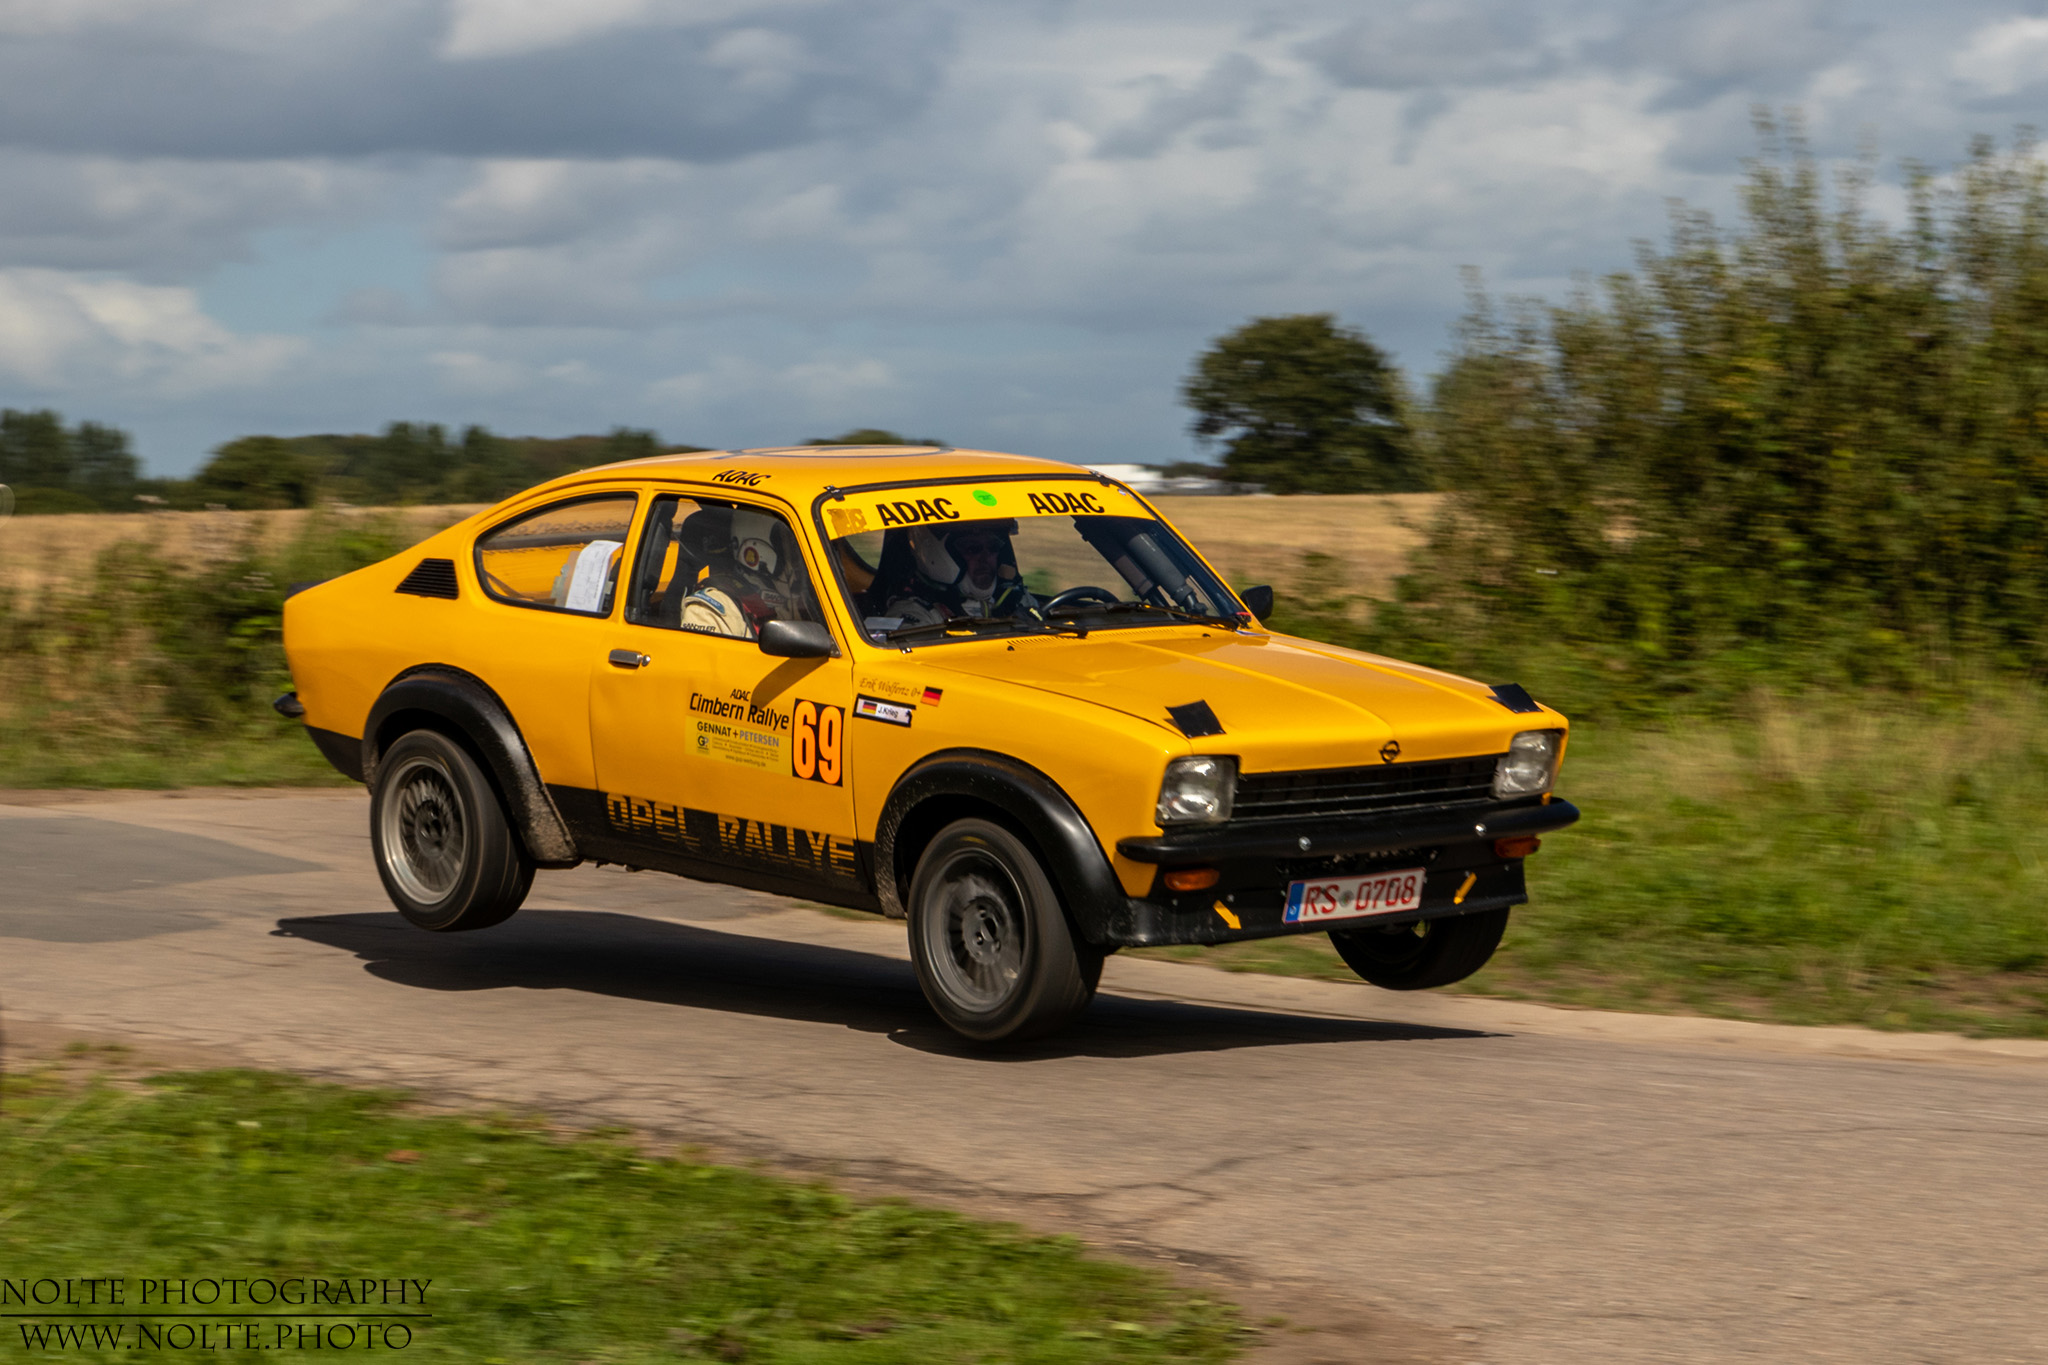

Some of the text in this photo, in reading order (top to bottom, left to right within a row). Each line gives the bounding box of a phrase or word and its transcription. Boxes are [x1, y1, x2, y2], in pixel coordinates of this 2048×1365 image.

[712, 469, 772, 487] ADAC
[875, 497, 960, 526] ADAC
[1027, 492, 1105, 514] ADAC
[730, 688, 750, 702] ADAC
[689, 692, 790, 731] Cimbern Rallye
[697, 721, 731, 737] GENNAT
[739, 730, 780, 747] PETERSEN
[793, 700, 842, 785] 69
[607, 793, 856, 877] OPEL RALLYE
[1303, 875, 1417, 916] RS 0708
